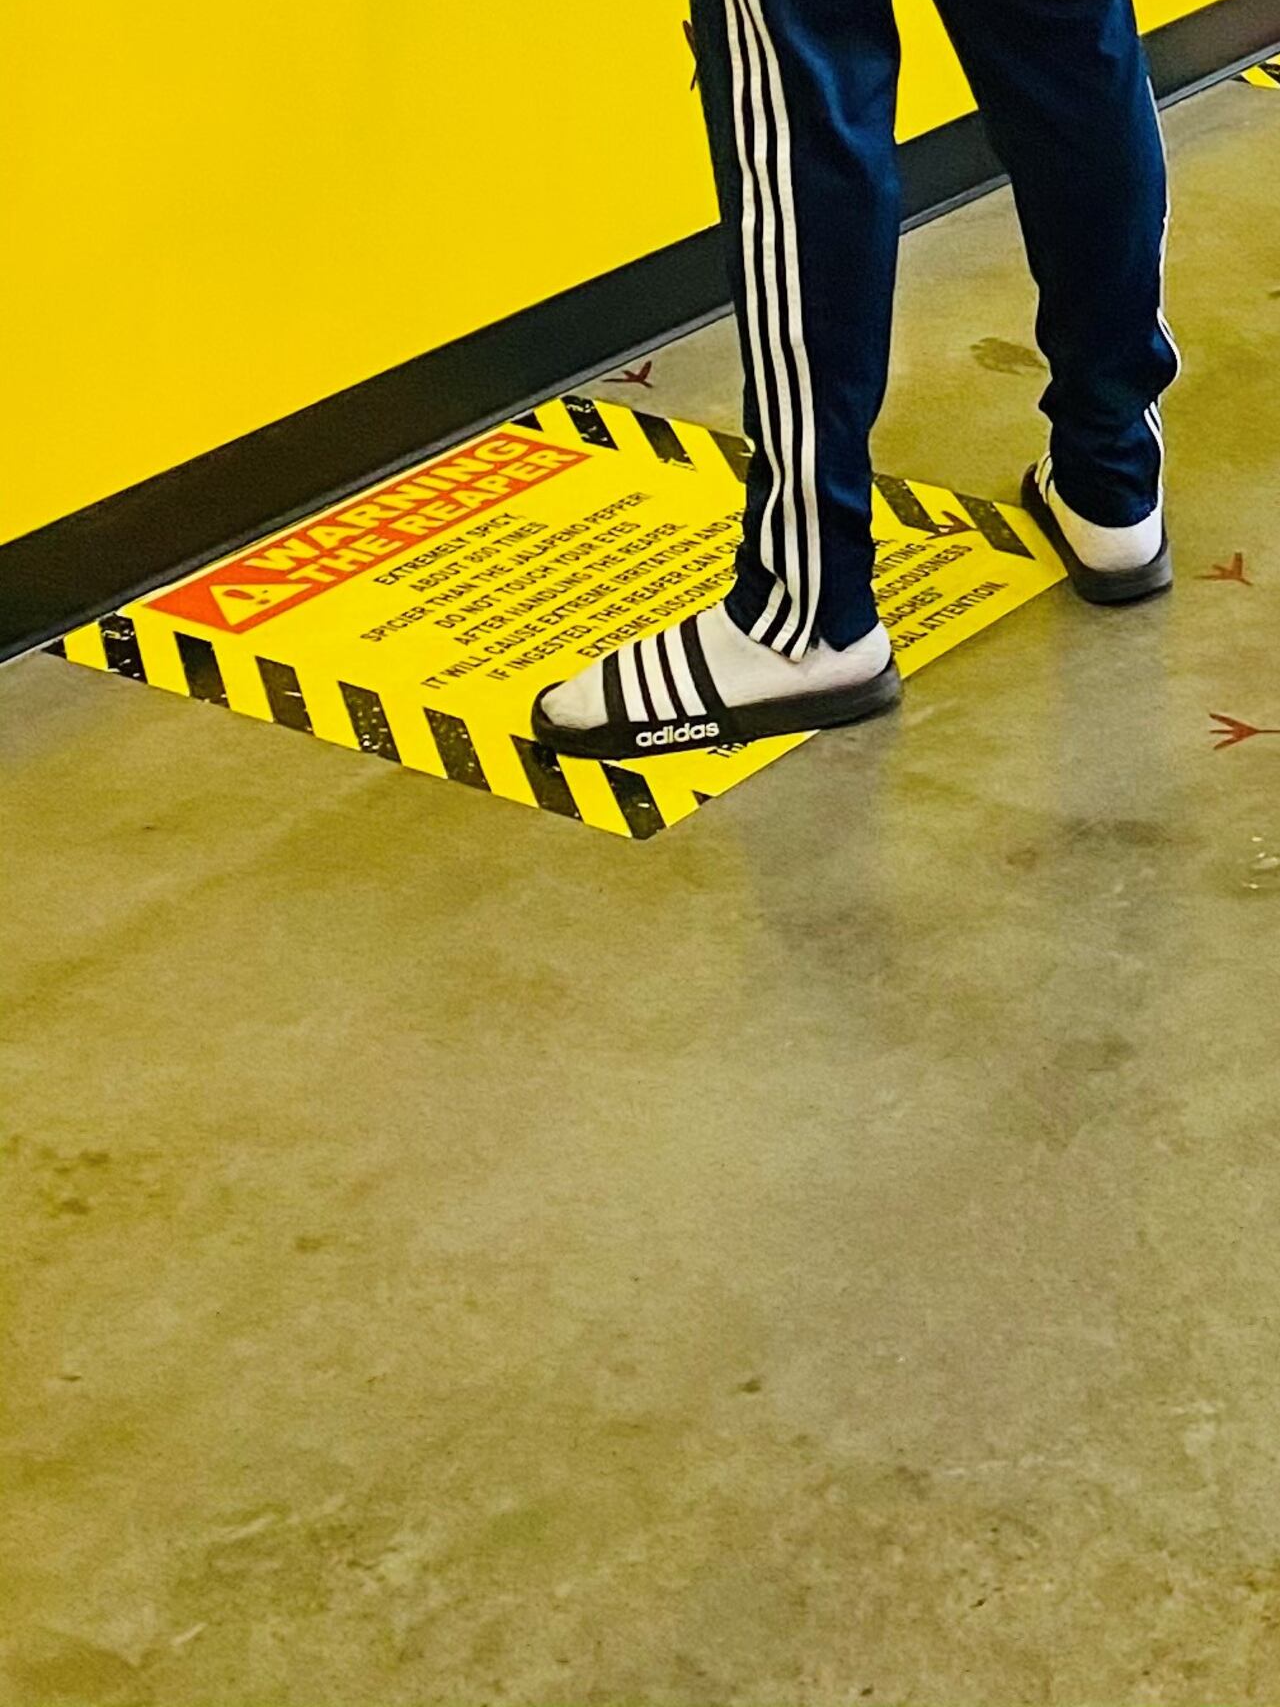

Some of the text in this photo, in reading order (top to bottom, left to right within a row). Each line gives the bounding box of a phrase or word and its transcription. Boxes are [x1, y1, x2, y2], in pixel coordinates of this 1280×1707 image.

[244, 439, 529, 572] WARNING
[285, 448, 579, 585] THE REAPER
[409, 561, 468, 592] ABOUT
[492, 521, 549, 547] TIMES
[360, 605, 435, 642] SPICIER
[425, 583, 480, 607] THAN
[471, 564, 514, 585] THE
[508, 523, 590, 566] JALAPENO
[373, 536, 470, 585] EXTREMELY
[420, 676, 448, 690] IT
[440, 655, 492, 679] WILL
[484, 623, 547, 655] CAUSE
[536, 582, 618, 626] EXTREME
[693, 521, 733, 541] AND
[434, 521, 641, 629] DO NOT TOUCH YOUR EYES
[452, 614, 514, 646] AFTER
[505, 571, 592, 617] HANDLING
[583, 553, 627, 573] THE
[485, 667, 512, 682] IF
[587, 606, 630, 625] THE
[621, 570, 692, 601] REAPER
[682, 552, 723, 574] CAN
[576, 614, 660, 659] EXTREME
[635, 721, 720, 747] adidas
